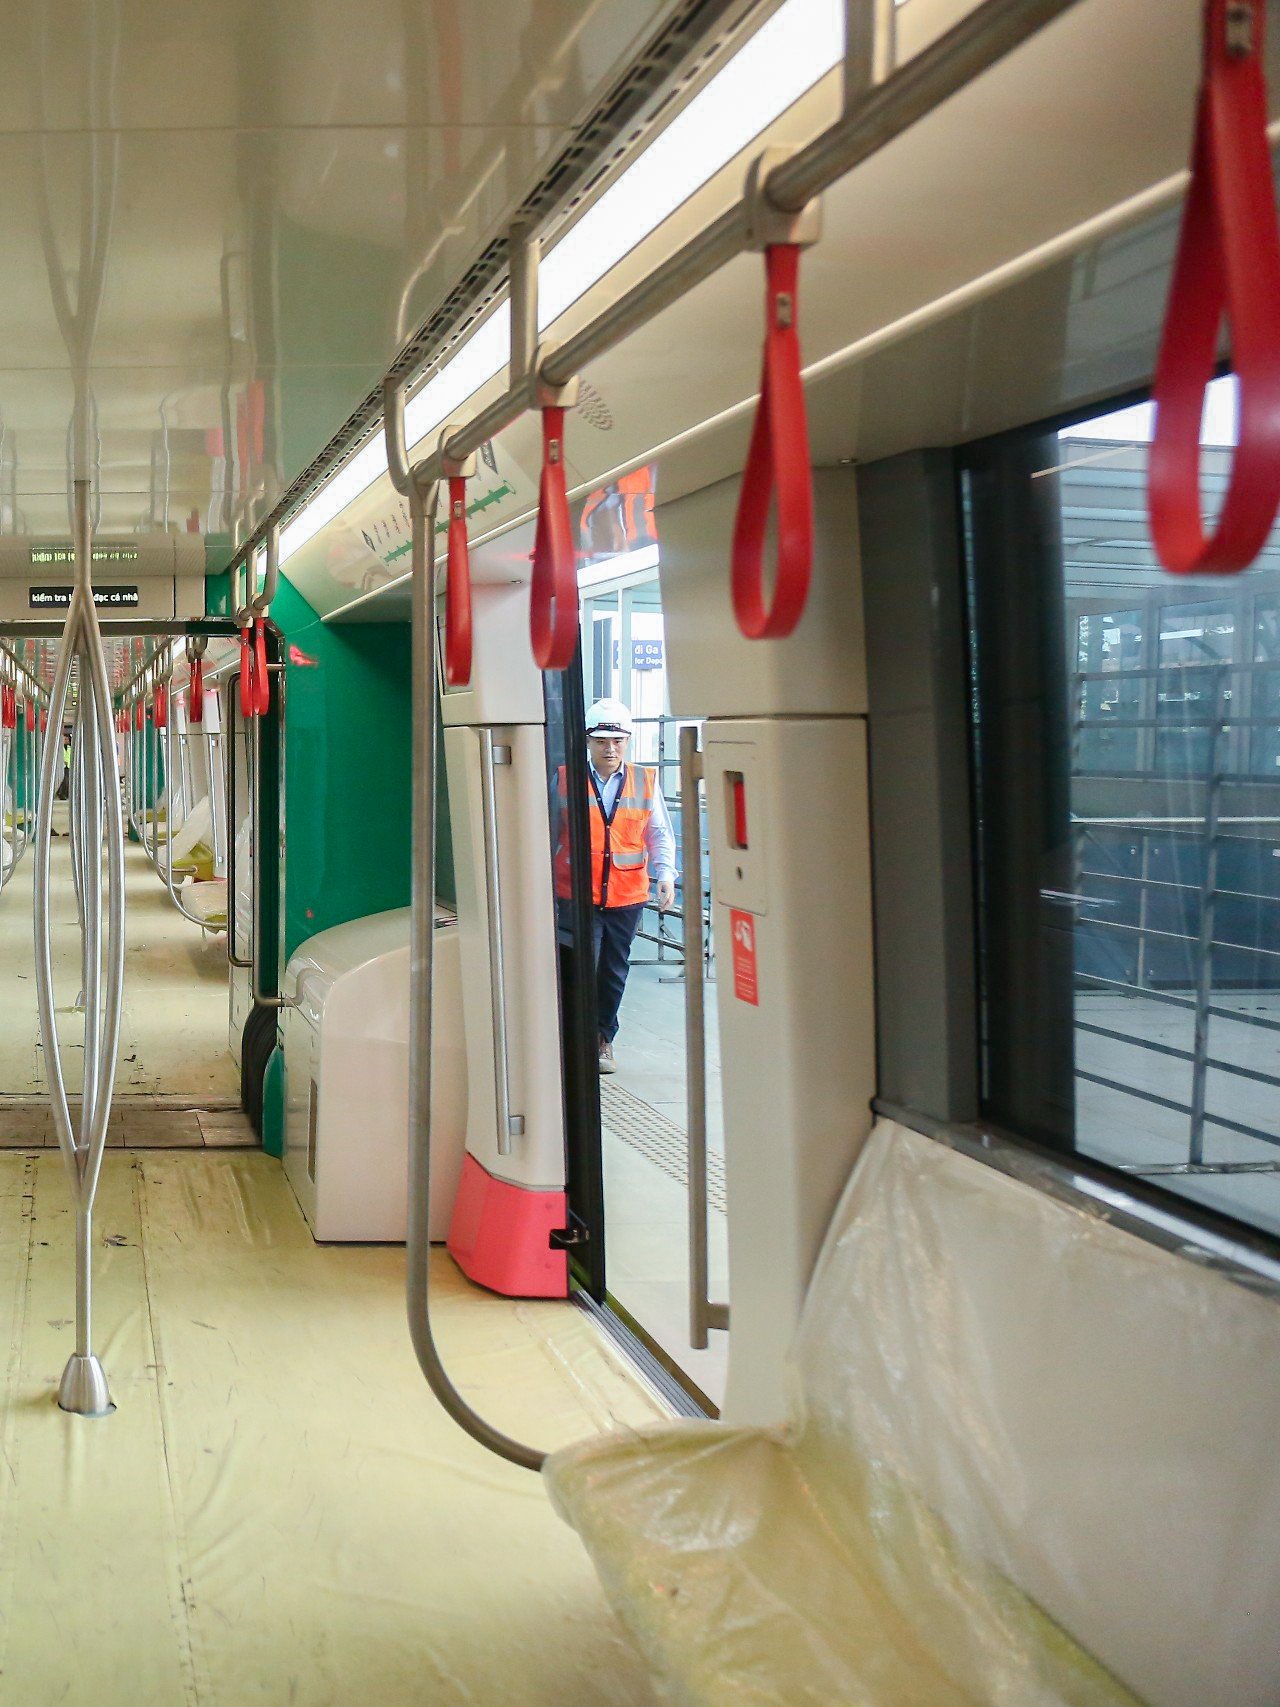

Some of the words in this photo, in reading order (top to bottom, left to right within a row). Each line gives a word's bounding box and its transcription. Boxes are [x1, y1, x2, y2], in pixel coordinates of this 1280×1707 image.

[54, 594, 67, 602] tra
[110, 592, 121, 602] cá
[645, 644, 659, 655] Ga
[634, 657, 645, 665] for
